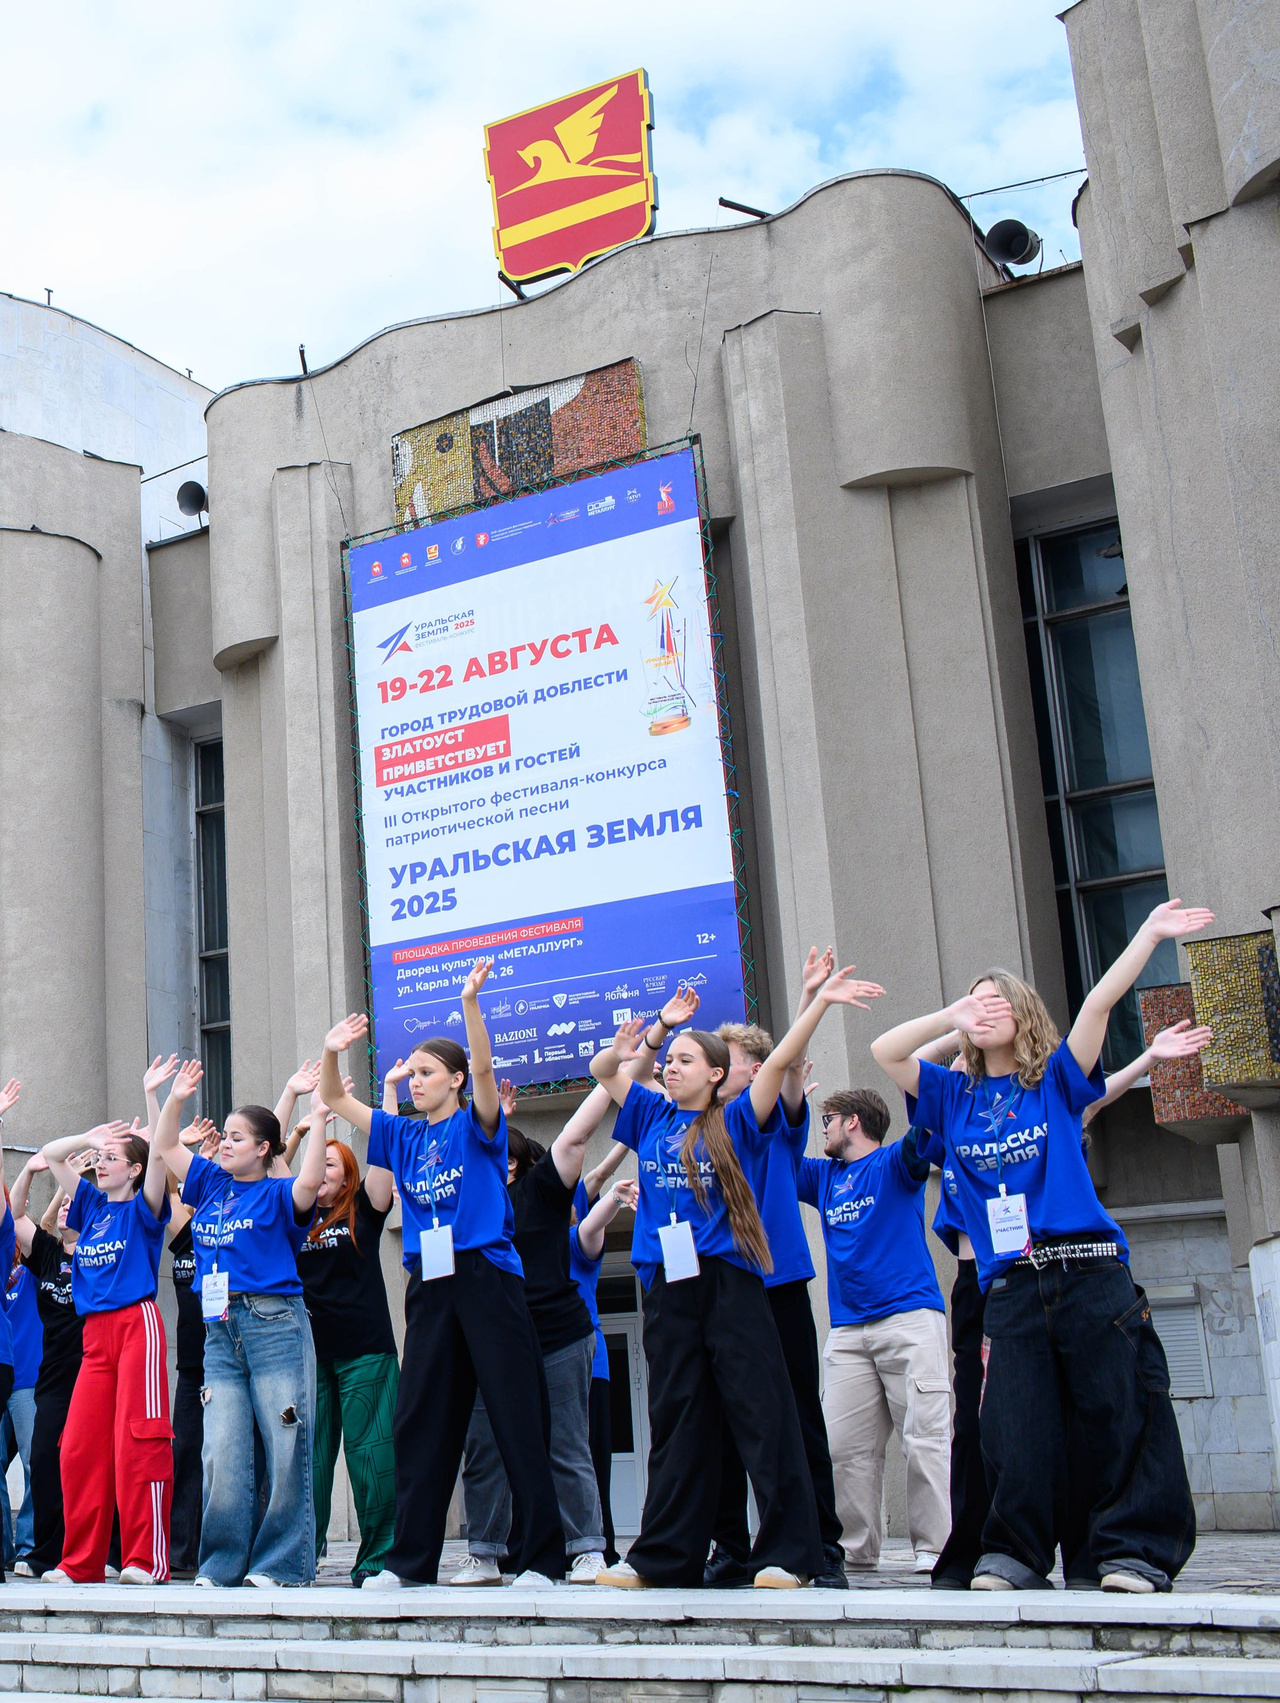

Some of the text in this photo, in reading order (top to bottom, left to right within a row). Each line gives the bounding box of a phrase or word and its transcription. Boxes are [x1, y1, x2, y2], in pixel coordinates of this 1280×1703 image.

[587, 505, 616, 516] МЕТАЛЛУРГ
[414, 609, 475, 632] УРАЛЬСКАЯ
[414, 619, 476, 641] ЗЕМЛЯ 2025
[377, 623, 620, 704] 19-22 АВГУСТА
[380, 668, 629, 740] ГОРОД ТРУДОВОЙ ДОБЛЕСТИ
[381, 728, 465, 761] ЗЛАТОУСТ
[382, 739, 508, 782] ПРИВЕТСТВУЕТ
[384, 742, 581, 801] УЧАСТНИКОВ И ГОСТЕЙ
[401, 797, 486, 826] Открытого
[490, 757, 668, 807] фестиваля-конкурса
[385, 799, 570, 848] патриотической песни
[389, 804, 704, 889] УРАЛЬСКАЯ ЗЕМЛЯ
[390, 887, 458, 921] 2025
[394, 918, 582, 962] ПЛОЩАДКА ПРОВЕДЕНИЯ ФЕСТИВАЛЯ
[696, 932, 717, 945] 12+
[396, 937, 584, 982] Дворец культуры «МЕТАЛЛУРГ»
[397, 966, 514, 997] ул. Карла Маа, 26
[494, 1027, 538, 1044] BAZIONI
[544, 1048, 567, 1057] Первый
[544, 1053, 574, 1062] областной
[975, 1144, 1040, 1173] ЗЕМЛЯ
[191, 1219, 254, 1235] РАЛСКАЯ
[995, 1225, 1024, 1234] УЧАСТНИК
[301, 1237, 338, 1253] ЕМЛЯ
[79, 1253, 116, 1268] ЗЕМЛЯ
[175, 1269, 196, 1279] ЗЕМ
